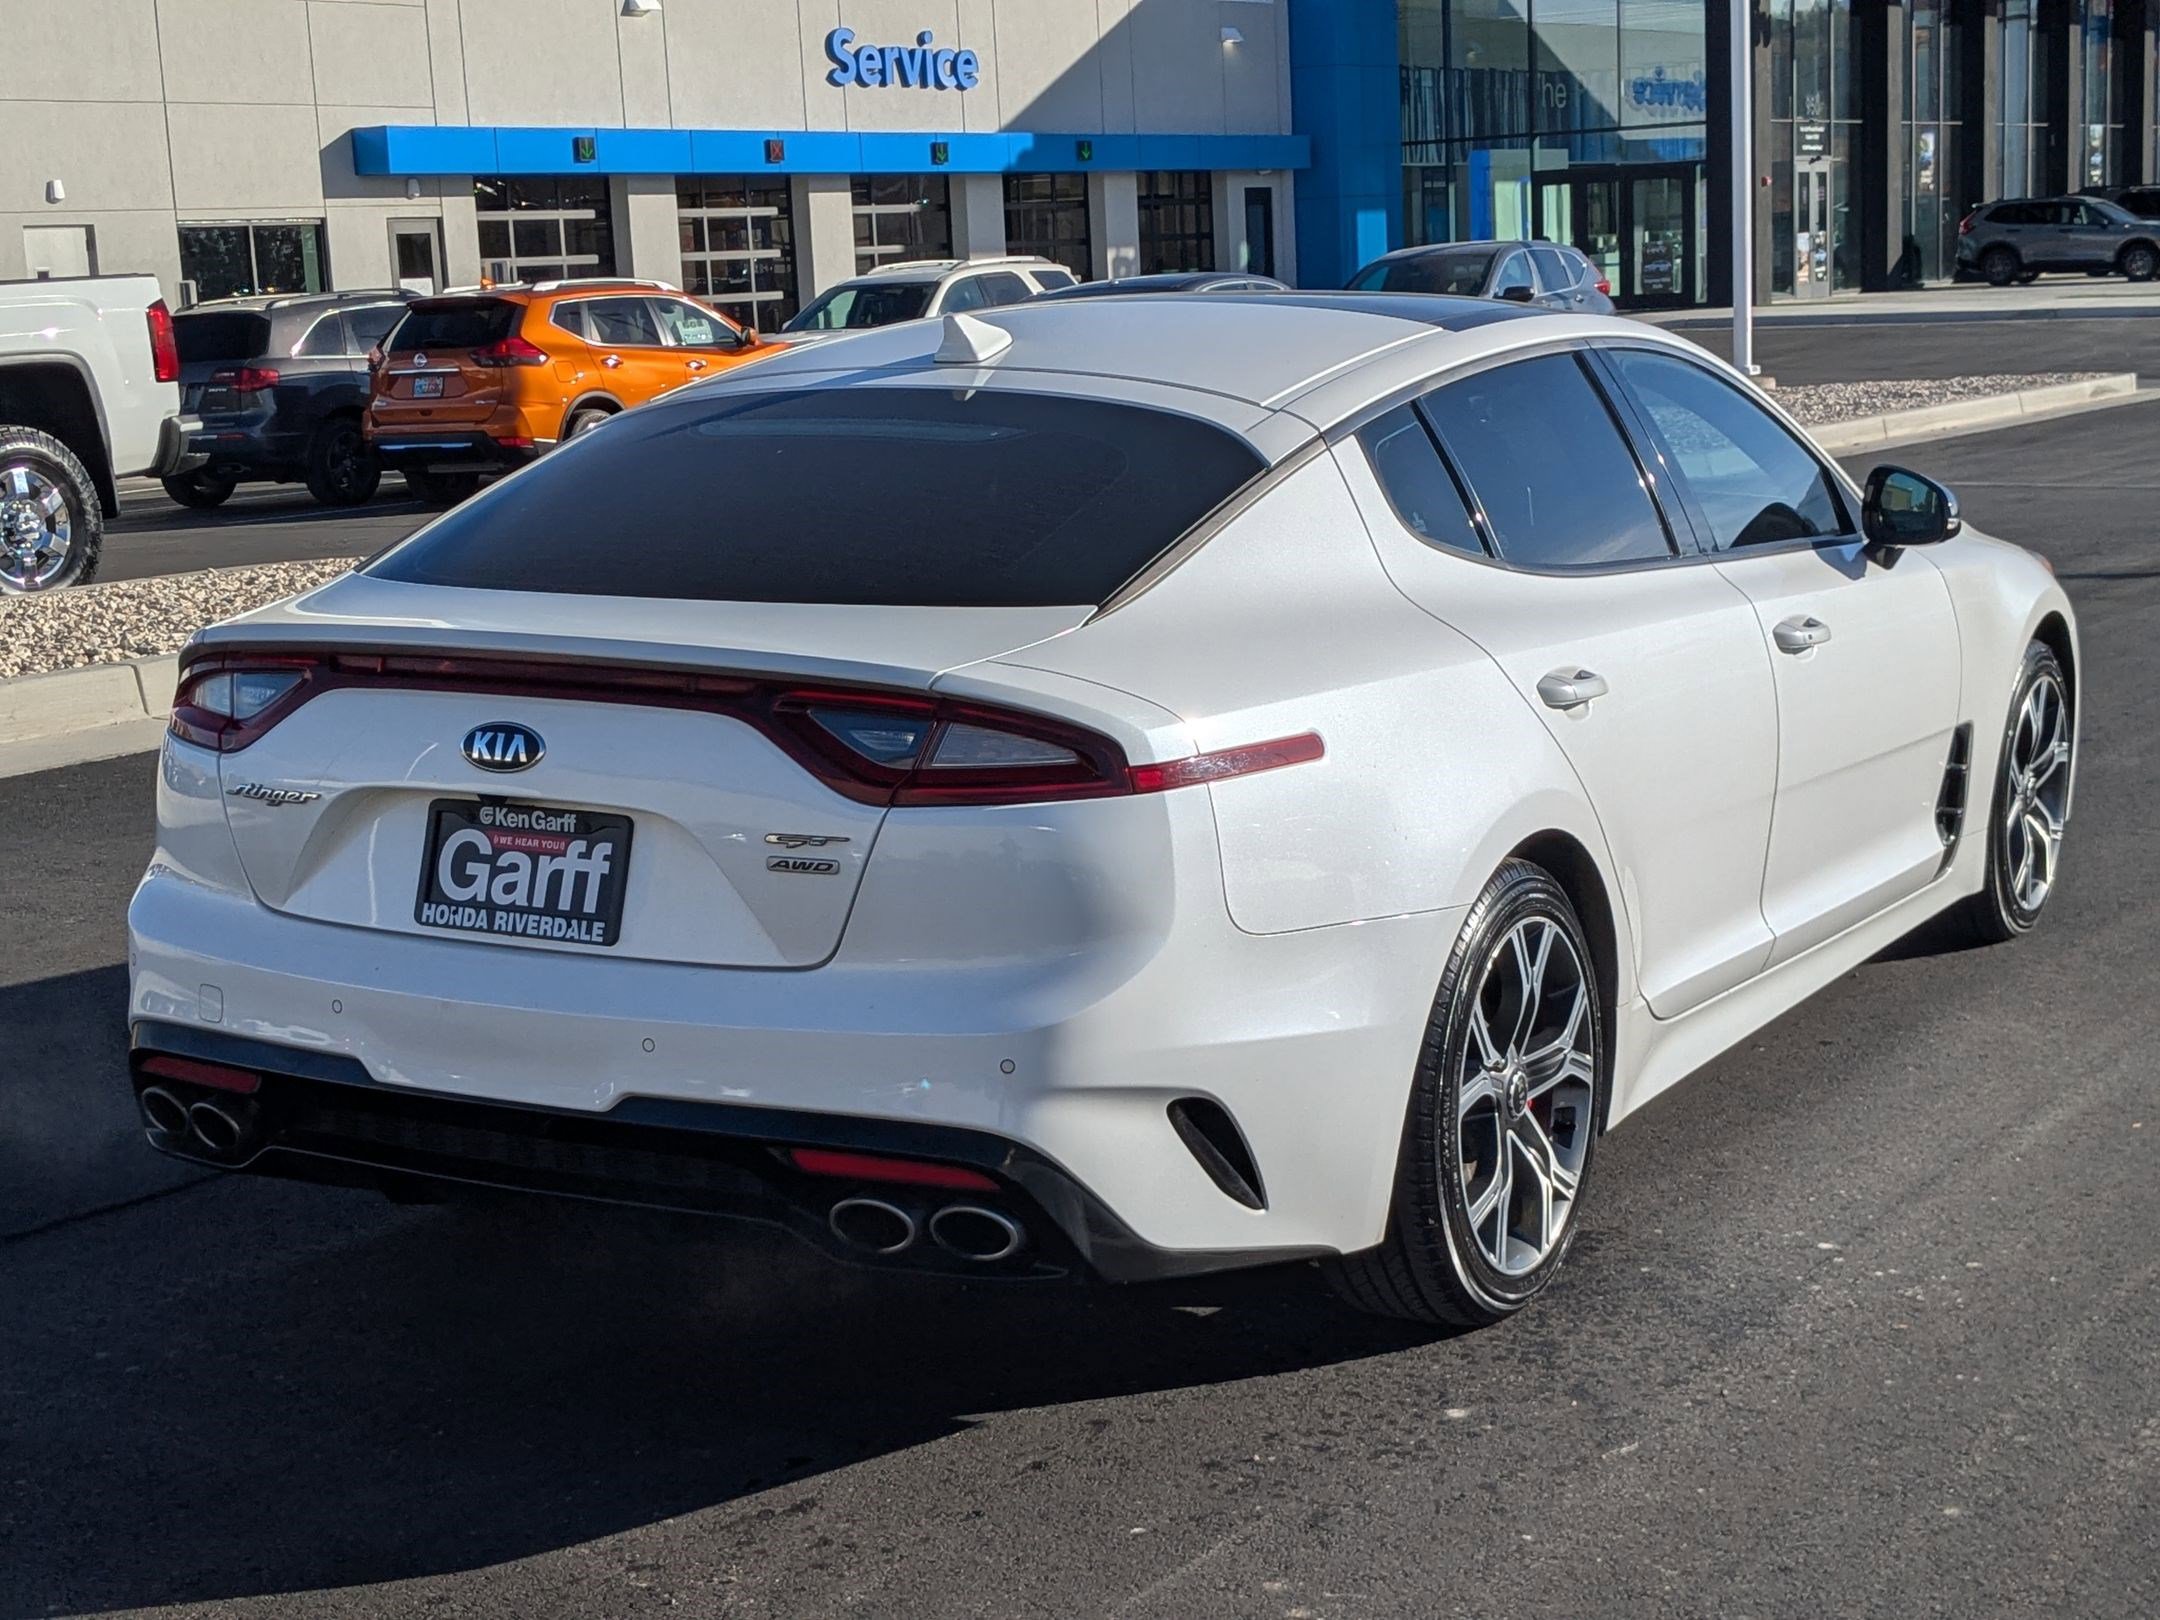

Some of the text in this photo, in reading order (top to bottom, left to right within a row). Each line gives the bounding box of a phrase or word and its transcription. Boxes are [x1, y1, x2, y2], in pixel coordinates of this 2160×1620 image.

[825, 27, 979, 91] Service
[472, 731, 527, 762] KIA
[495, 806, 577, 833] Ken Garff
[500, 836, 559, 850] WE HEAR YOU
[438, 828, 612, 914] Garff
[770, 860, 834, 872] AWD
[421, 903, 605, 942] HONDA RIVERDALE
